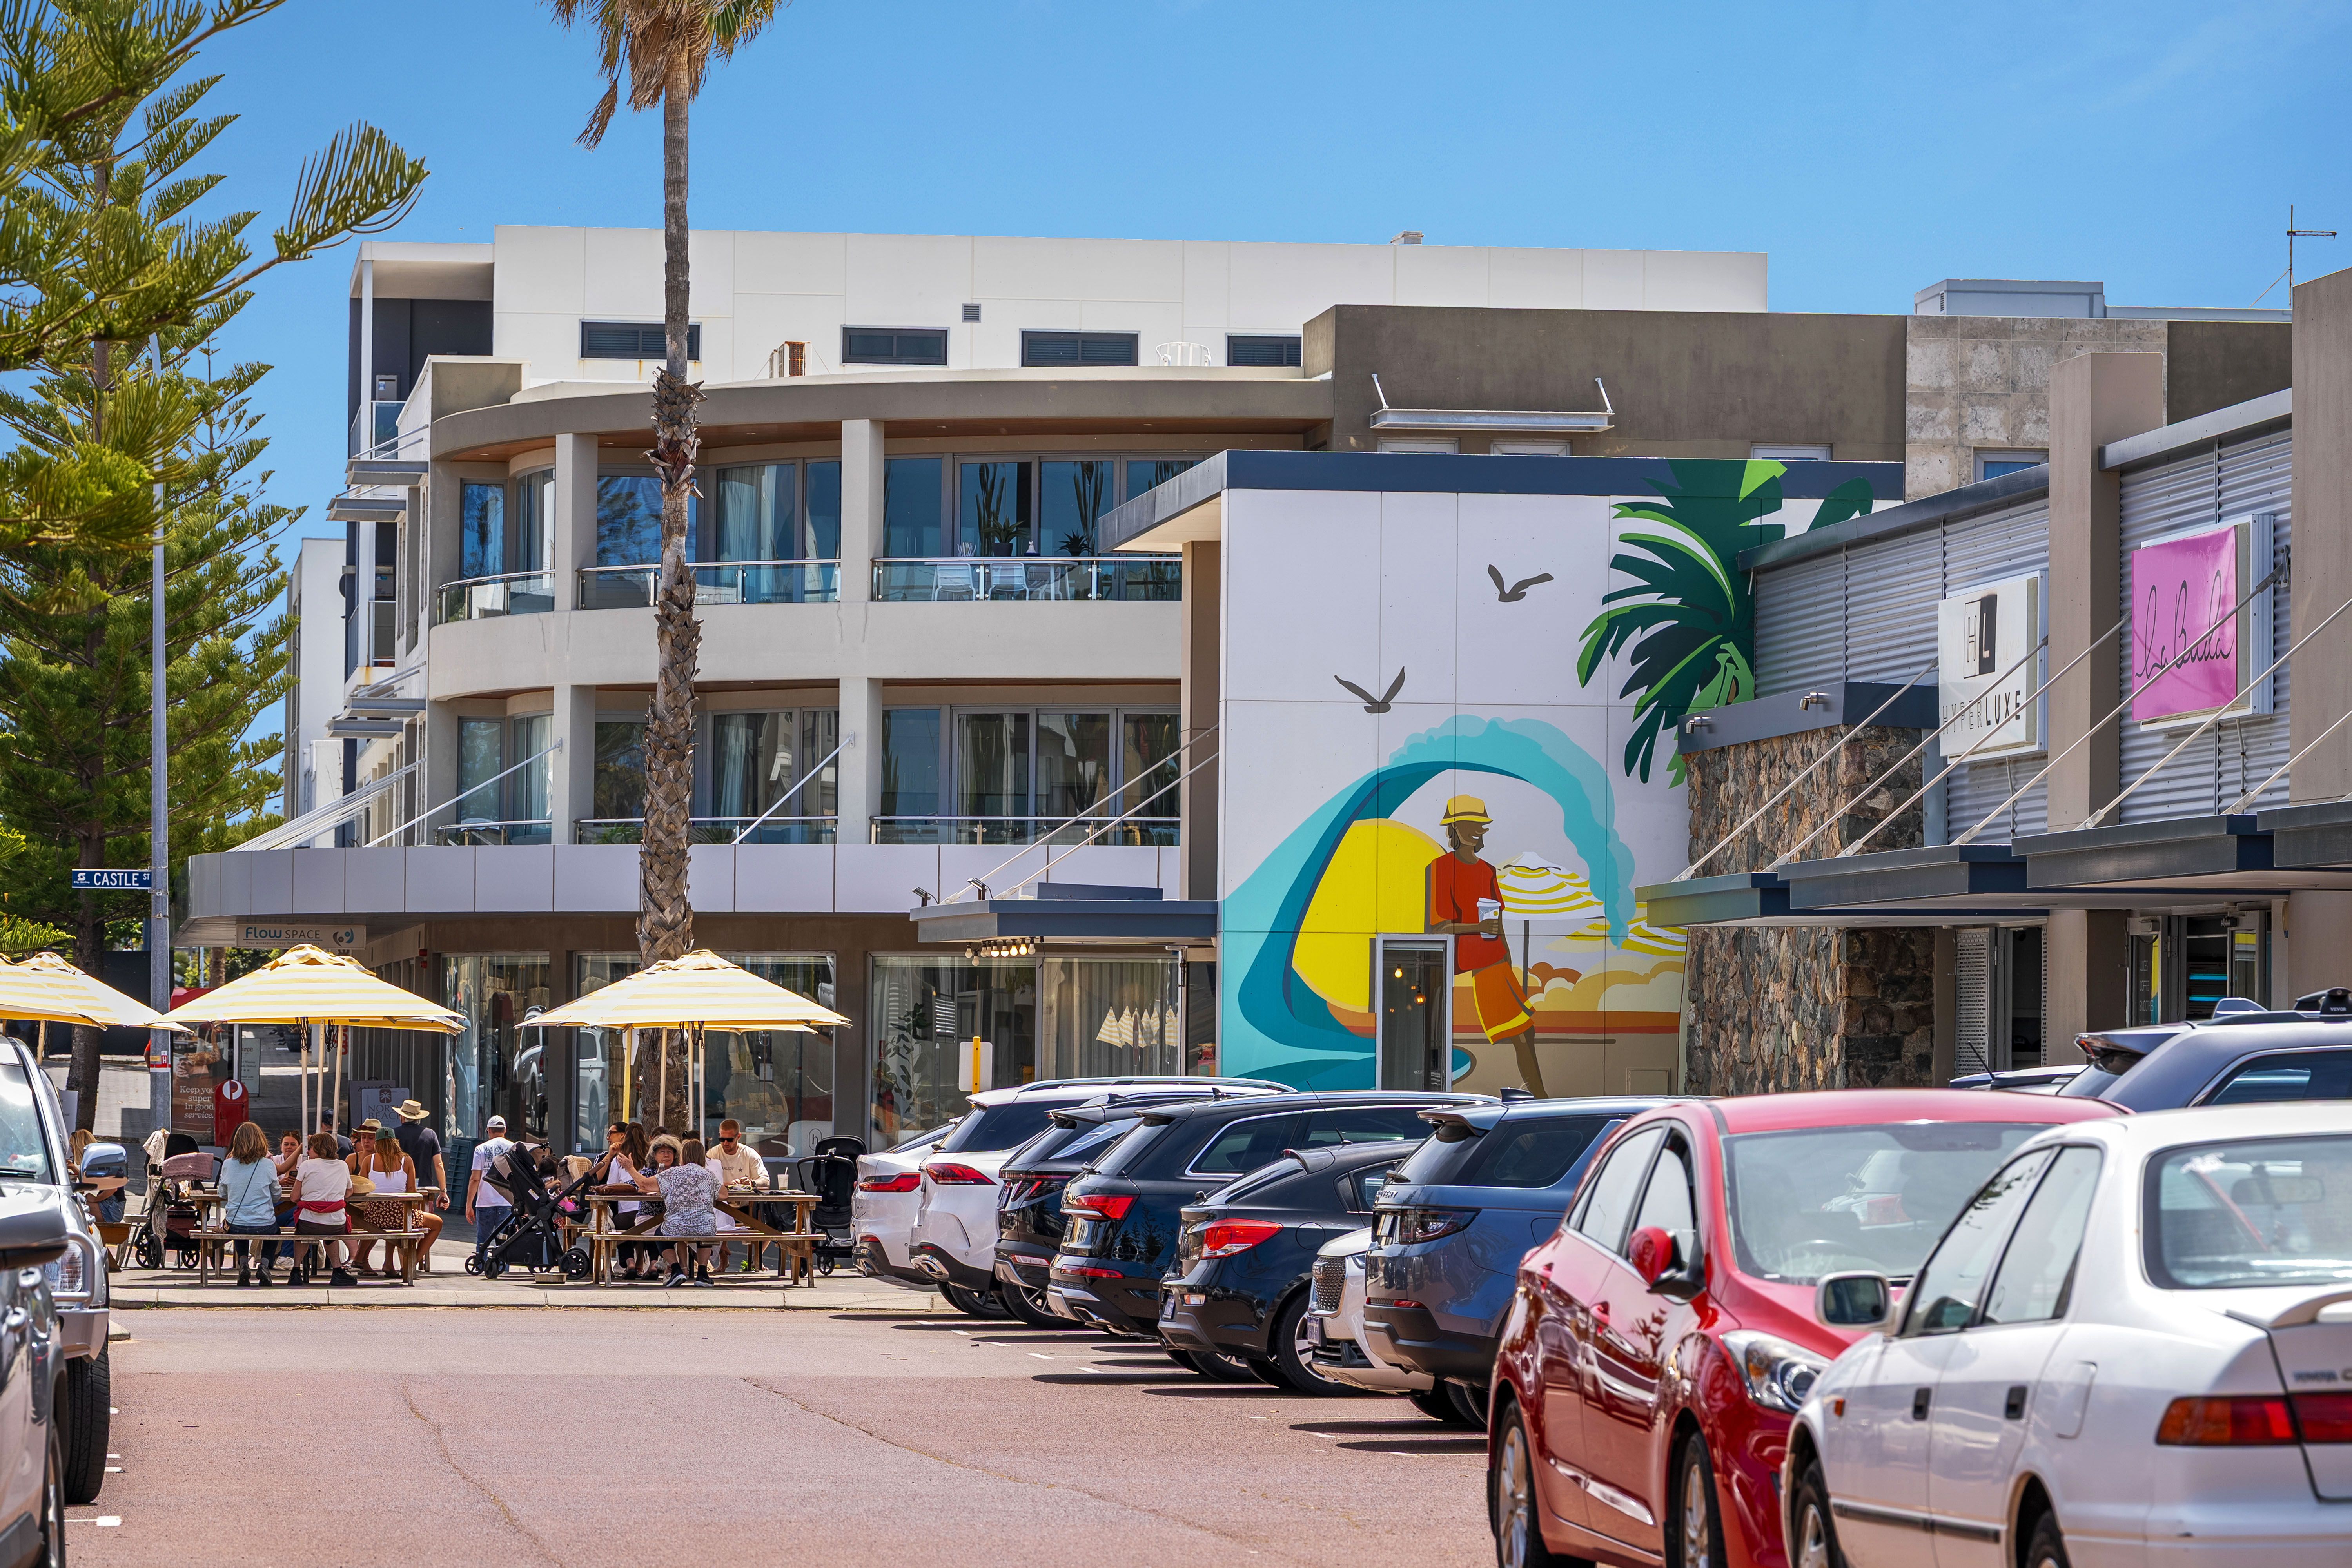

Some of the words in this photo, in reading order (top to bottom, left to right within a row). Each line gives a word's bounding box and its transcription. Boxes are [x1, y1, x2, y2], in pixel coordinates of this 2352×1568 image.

[94, 872, 139, 886] CASTLE
[285, 930, 320, 939] SPACE
[180, 1085, 200, 1095] Keep
